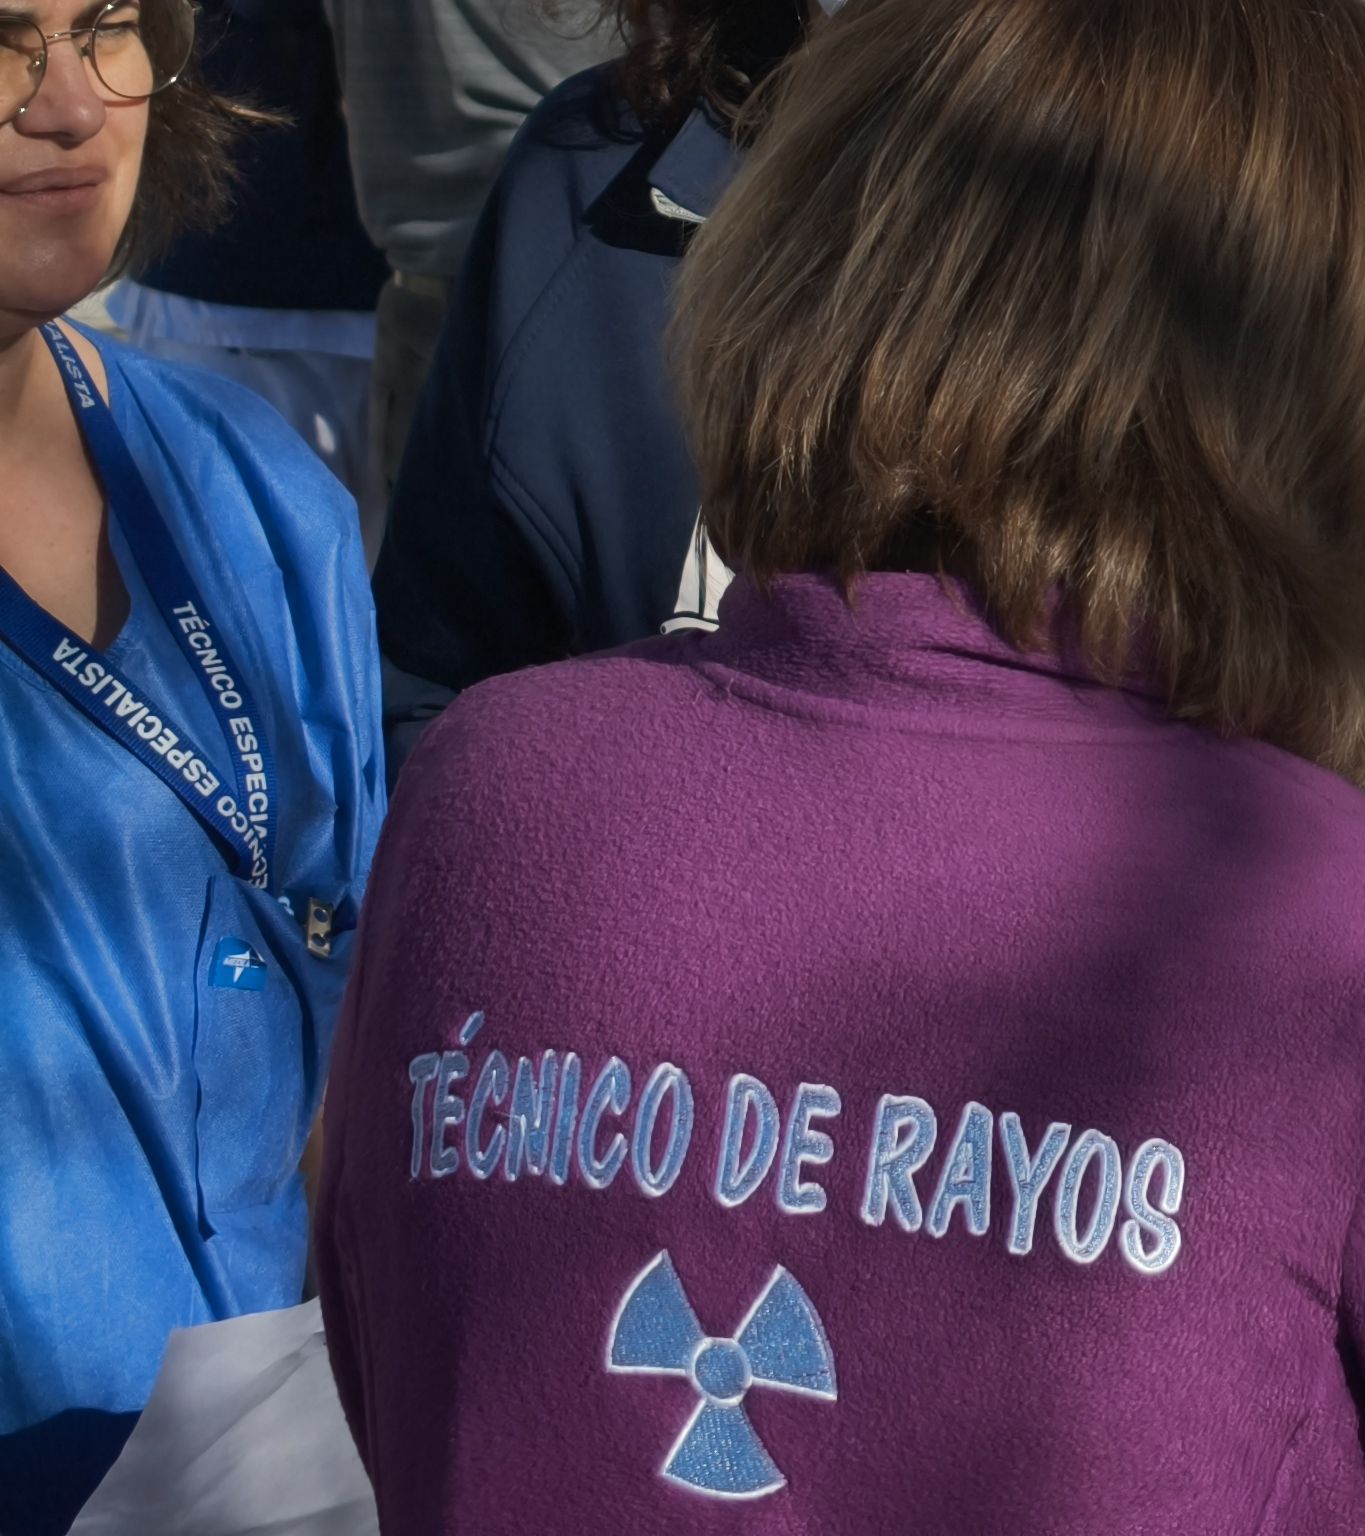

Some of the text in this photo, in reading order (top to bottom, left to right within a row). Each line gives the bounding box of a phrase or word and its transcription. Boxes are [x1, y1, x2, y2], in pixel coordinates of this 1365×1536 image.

[52, 637, 220, 798] ESPECIALISTA
[172, 600, 243, 709] TÉCNICO
[408, 1011, 1185, 1273] TÉCNICO DE RAYOS
